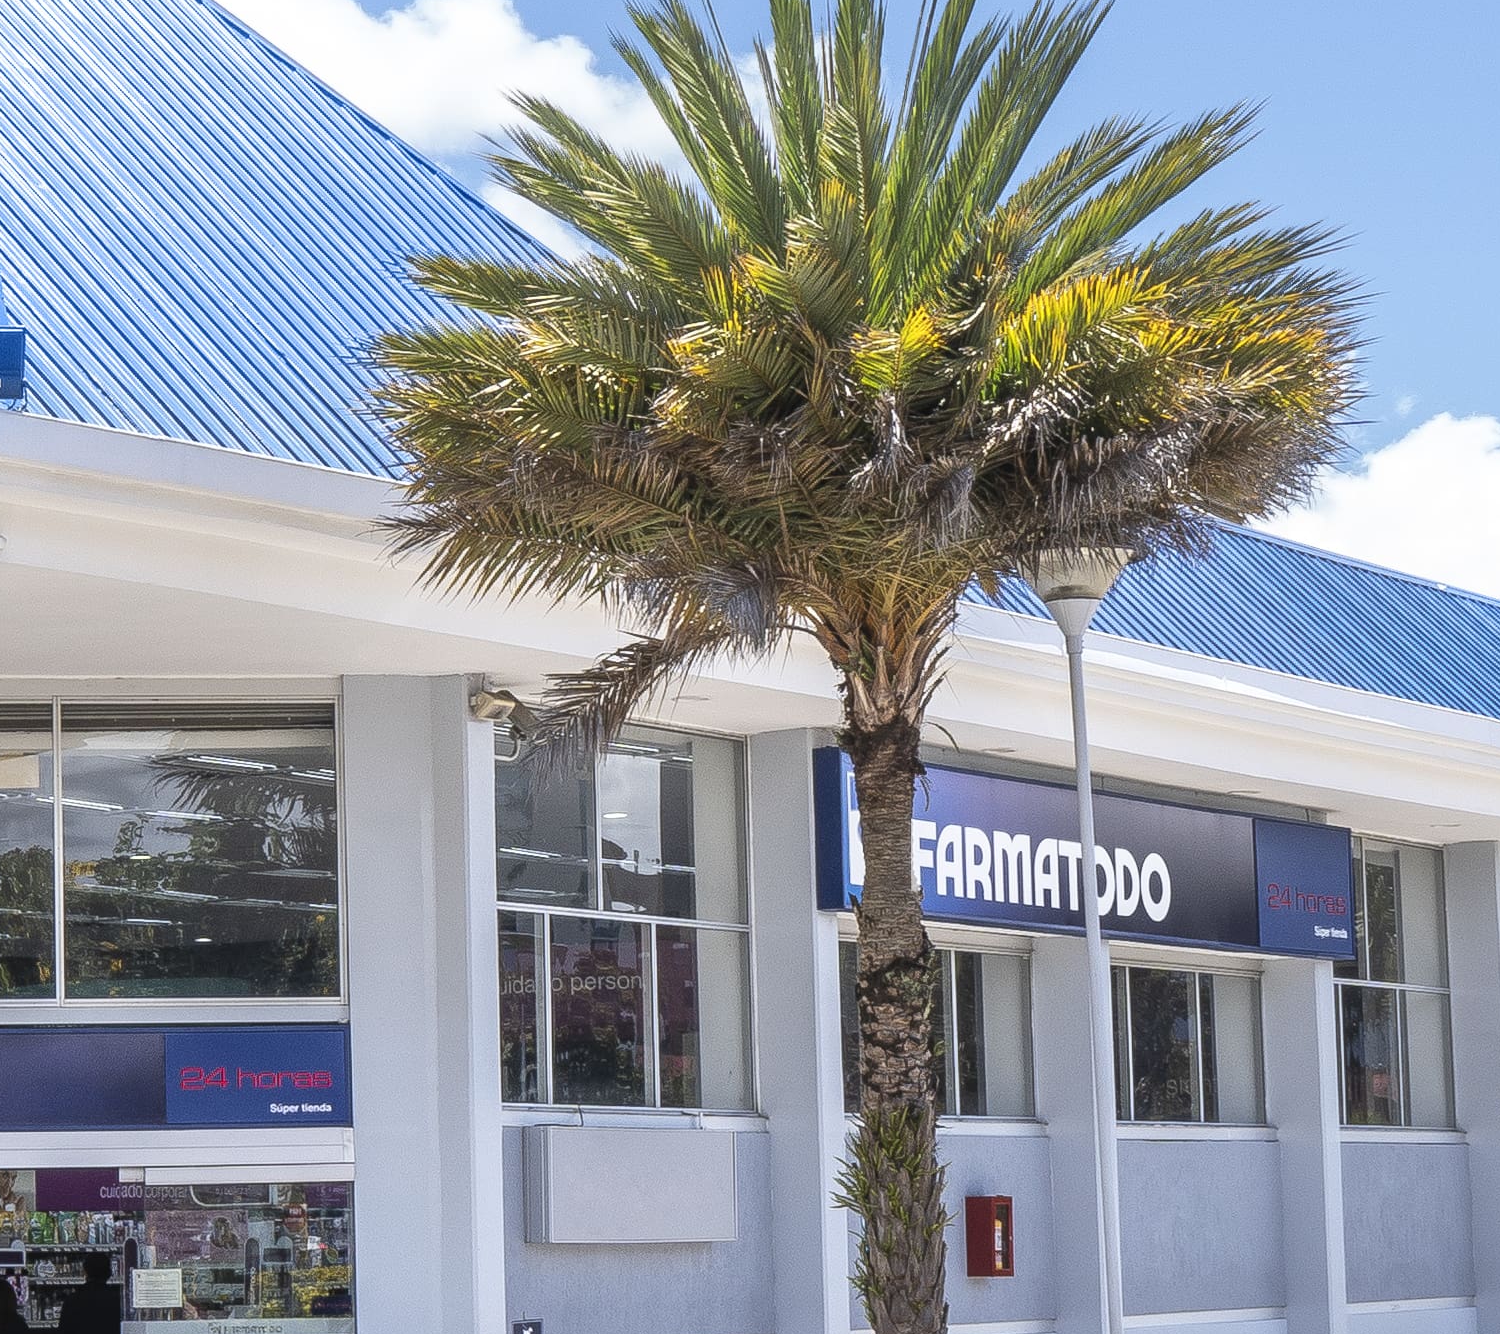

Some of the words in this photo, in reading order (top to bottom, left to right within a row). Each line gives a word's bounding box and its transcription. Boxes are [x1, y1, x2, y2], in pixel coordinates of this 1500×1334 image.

[911, 818, 1172, 923] FARMATODO
[1267, 883, 1292, 910] 24
[1295, 885, 1347, 915] horas
[180, 1067, 229, 1091] 24
[236, 1067, 334, 1089] horas
[270, 1103, 299, 1115] Súper
[301, 1103, 332, 1113] tienda
